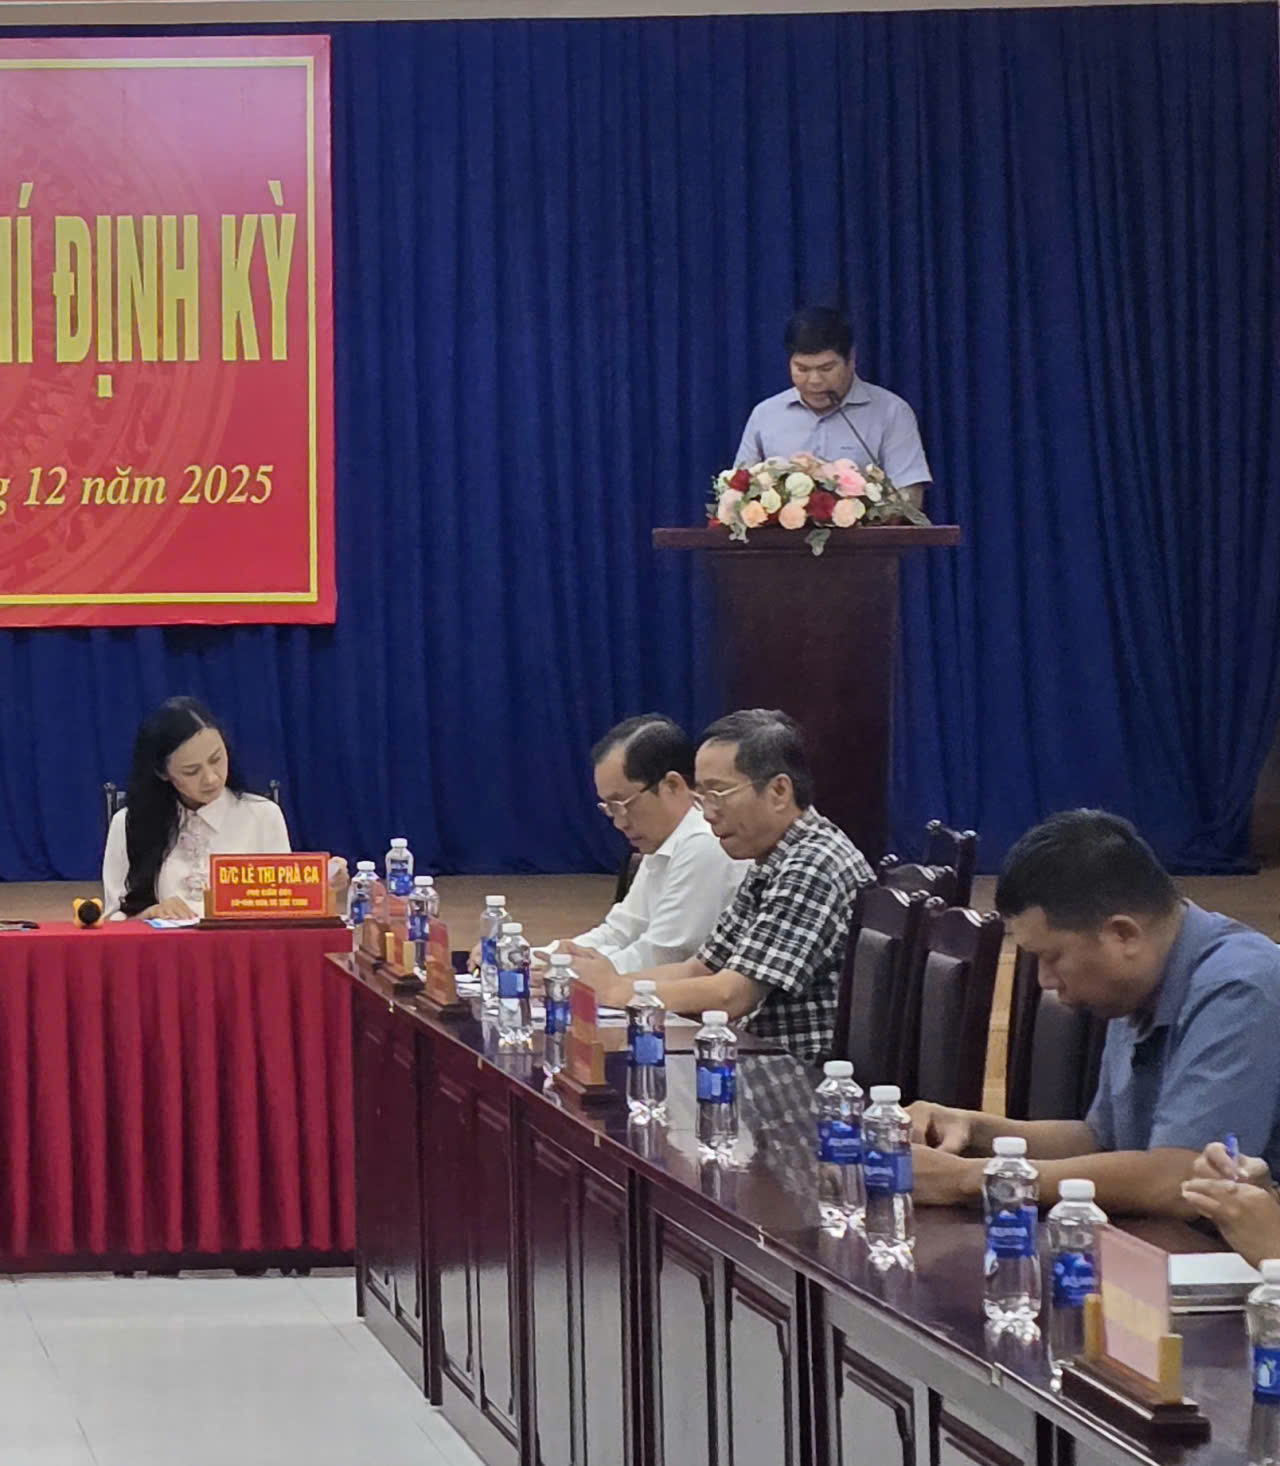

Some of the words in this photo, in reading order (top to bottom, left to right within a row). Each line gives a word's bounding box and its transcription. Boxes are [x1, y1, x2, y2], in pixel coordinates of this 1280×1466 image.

[52, 214, 200, 398] ĐỊNH
[221, 180, 297, 362] KỲ
[25, 466, 68, 506] 12
[80, 466, 167, 506] năm
[179, 464, 274, 506] 2025
